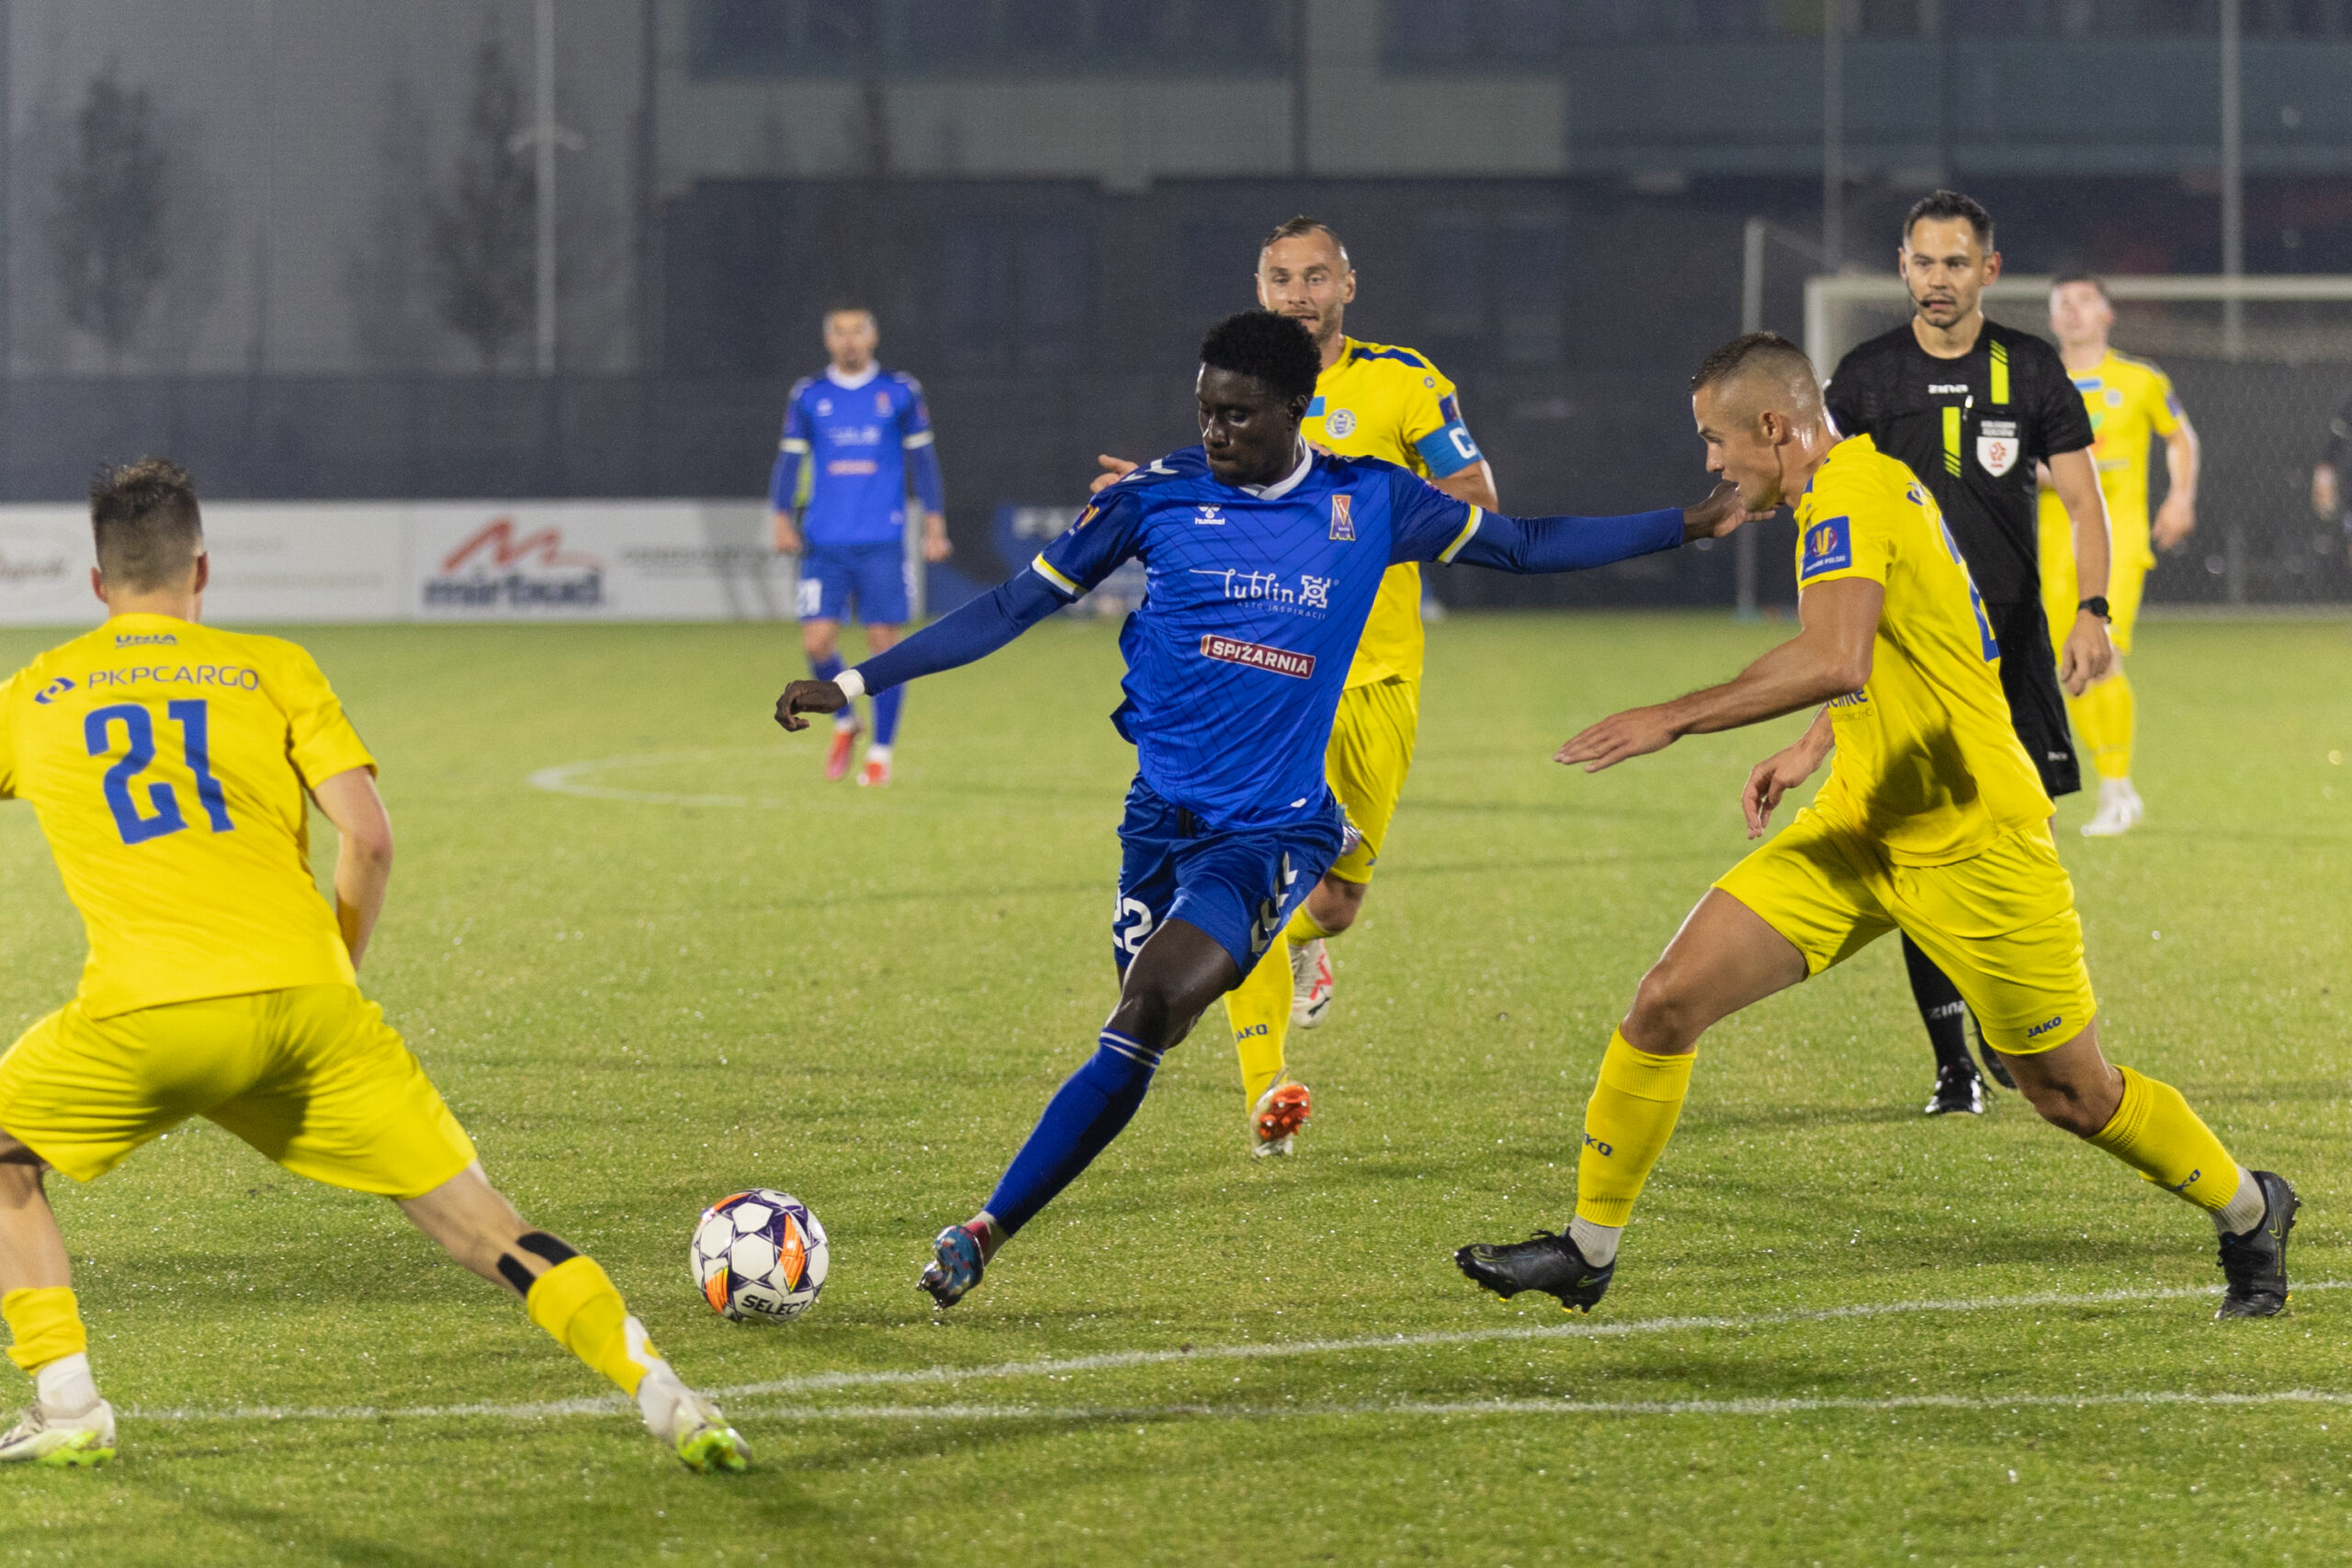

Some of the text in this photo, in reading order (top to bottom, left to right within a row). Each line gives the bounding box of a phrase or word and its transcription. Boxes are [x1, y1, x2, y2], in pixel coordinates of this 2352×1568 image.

[1449, 427, 1477, 459] C
[1194, 517, 1226, 525] hummel
[115, 634, 178, 643] UNIA
[1212, 640, 1308, 675] SPIŻARNIA
[84, 698, 236, 845] 21
[1236, 1023, 1268, 1043] AKO
[2027, 1016, 2062, 1038] JAKO
[741, 1293, 808, 1315] SELECT
